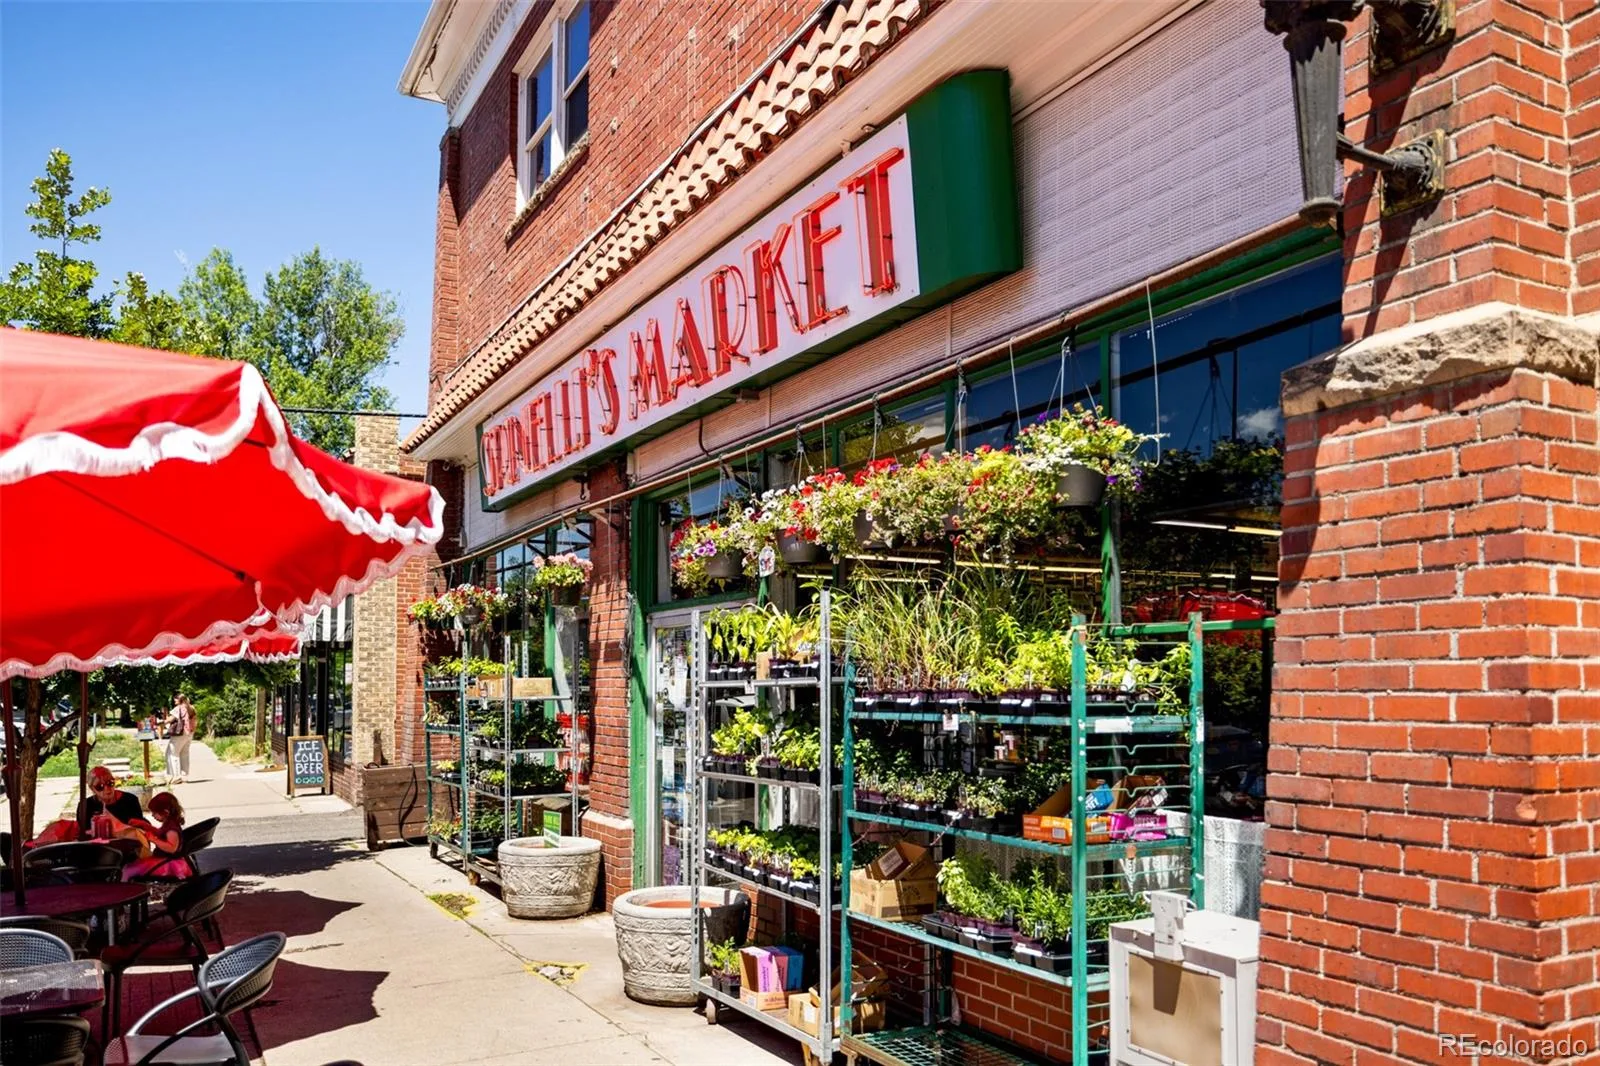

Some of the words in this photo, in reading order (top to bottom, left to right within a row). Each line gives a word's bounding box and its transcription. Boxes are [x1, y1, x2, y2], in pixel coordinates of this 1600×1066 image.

[628, 146, 905, 421] MARKET
[297, 740, 319, 751] ICE
[294, 752, 324, 763] COLD
[295, 763, 325, 775] BEER
